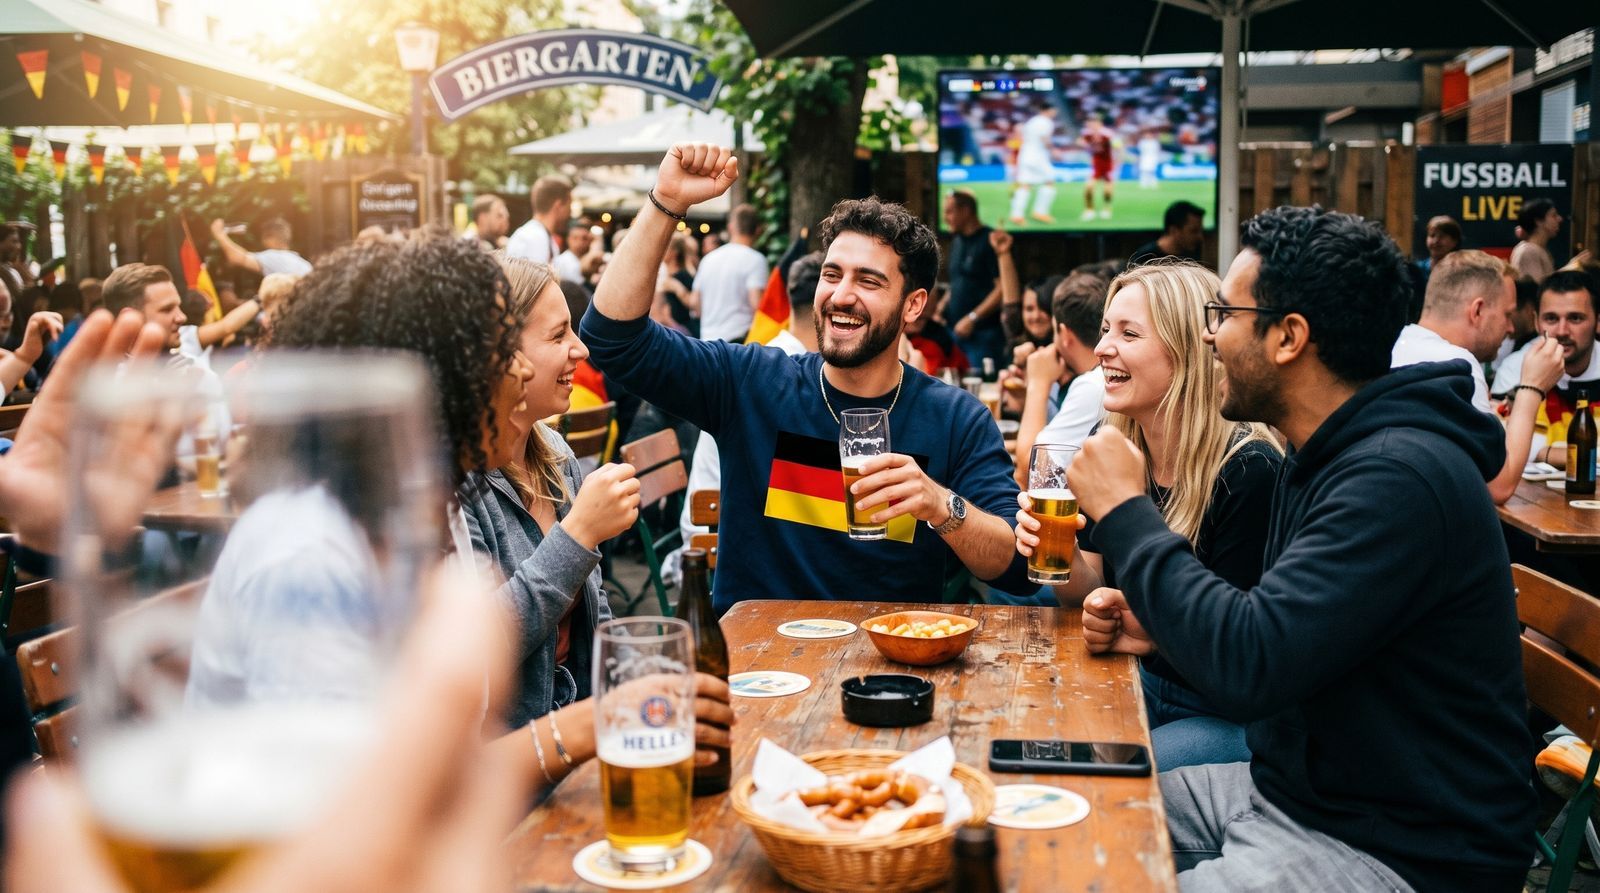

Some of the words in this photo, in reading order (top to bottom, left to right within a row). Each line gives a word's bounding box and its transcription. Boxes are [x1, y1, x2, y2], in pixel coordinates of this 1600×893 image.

[452, 39, 700, 101] BIERGARTEN
[1423, 162, 1567, 189] FUSSBALL
[1461, 195, 1524, 221] LIVE
